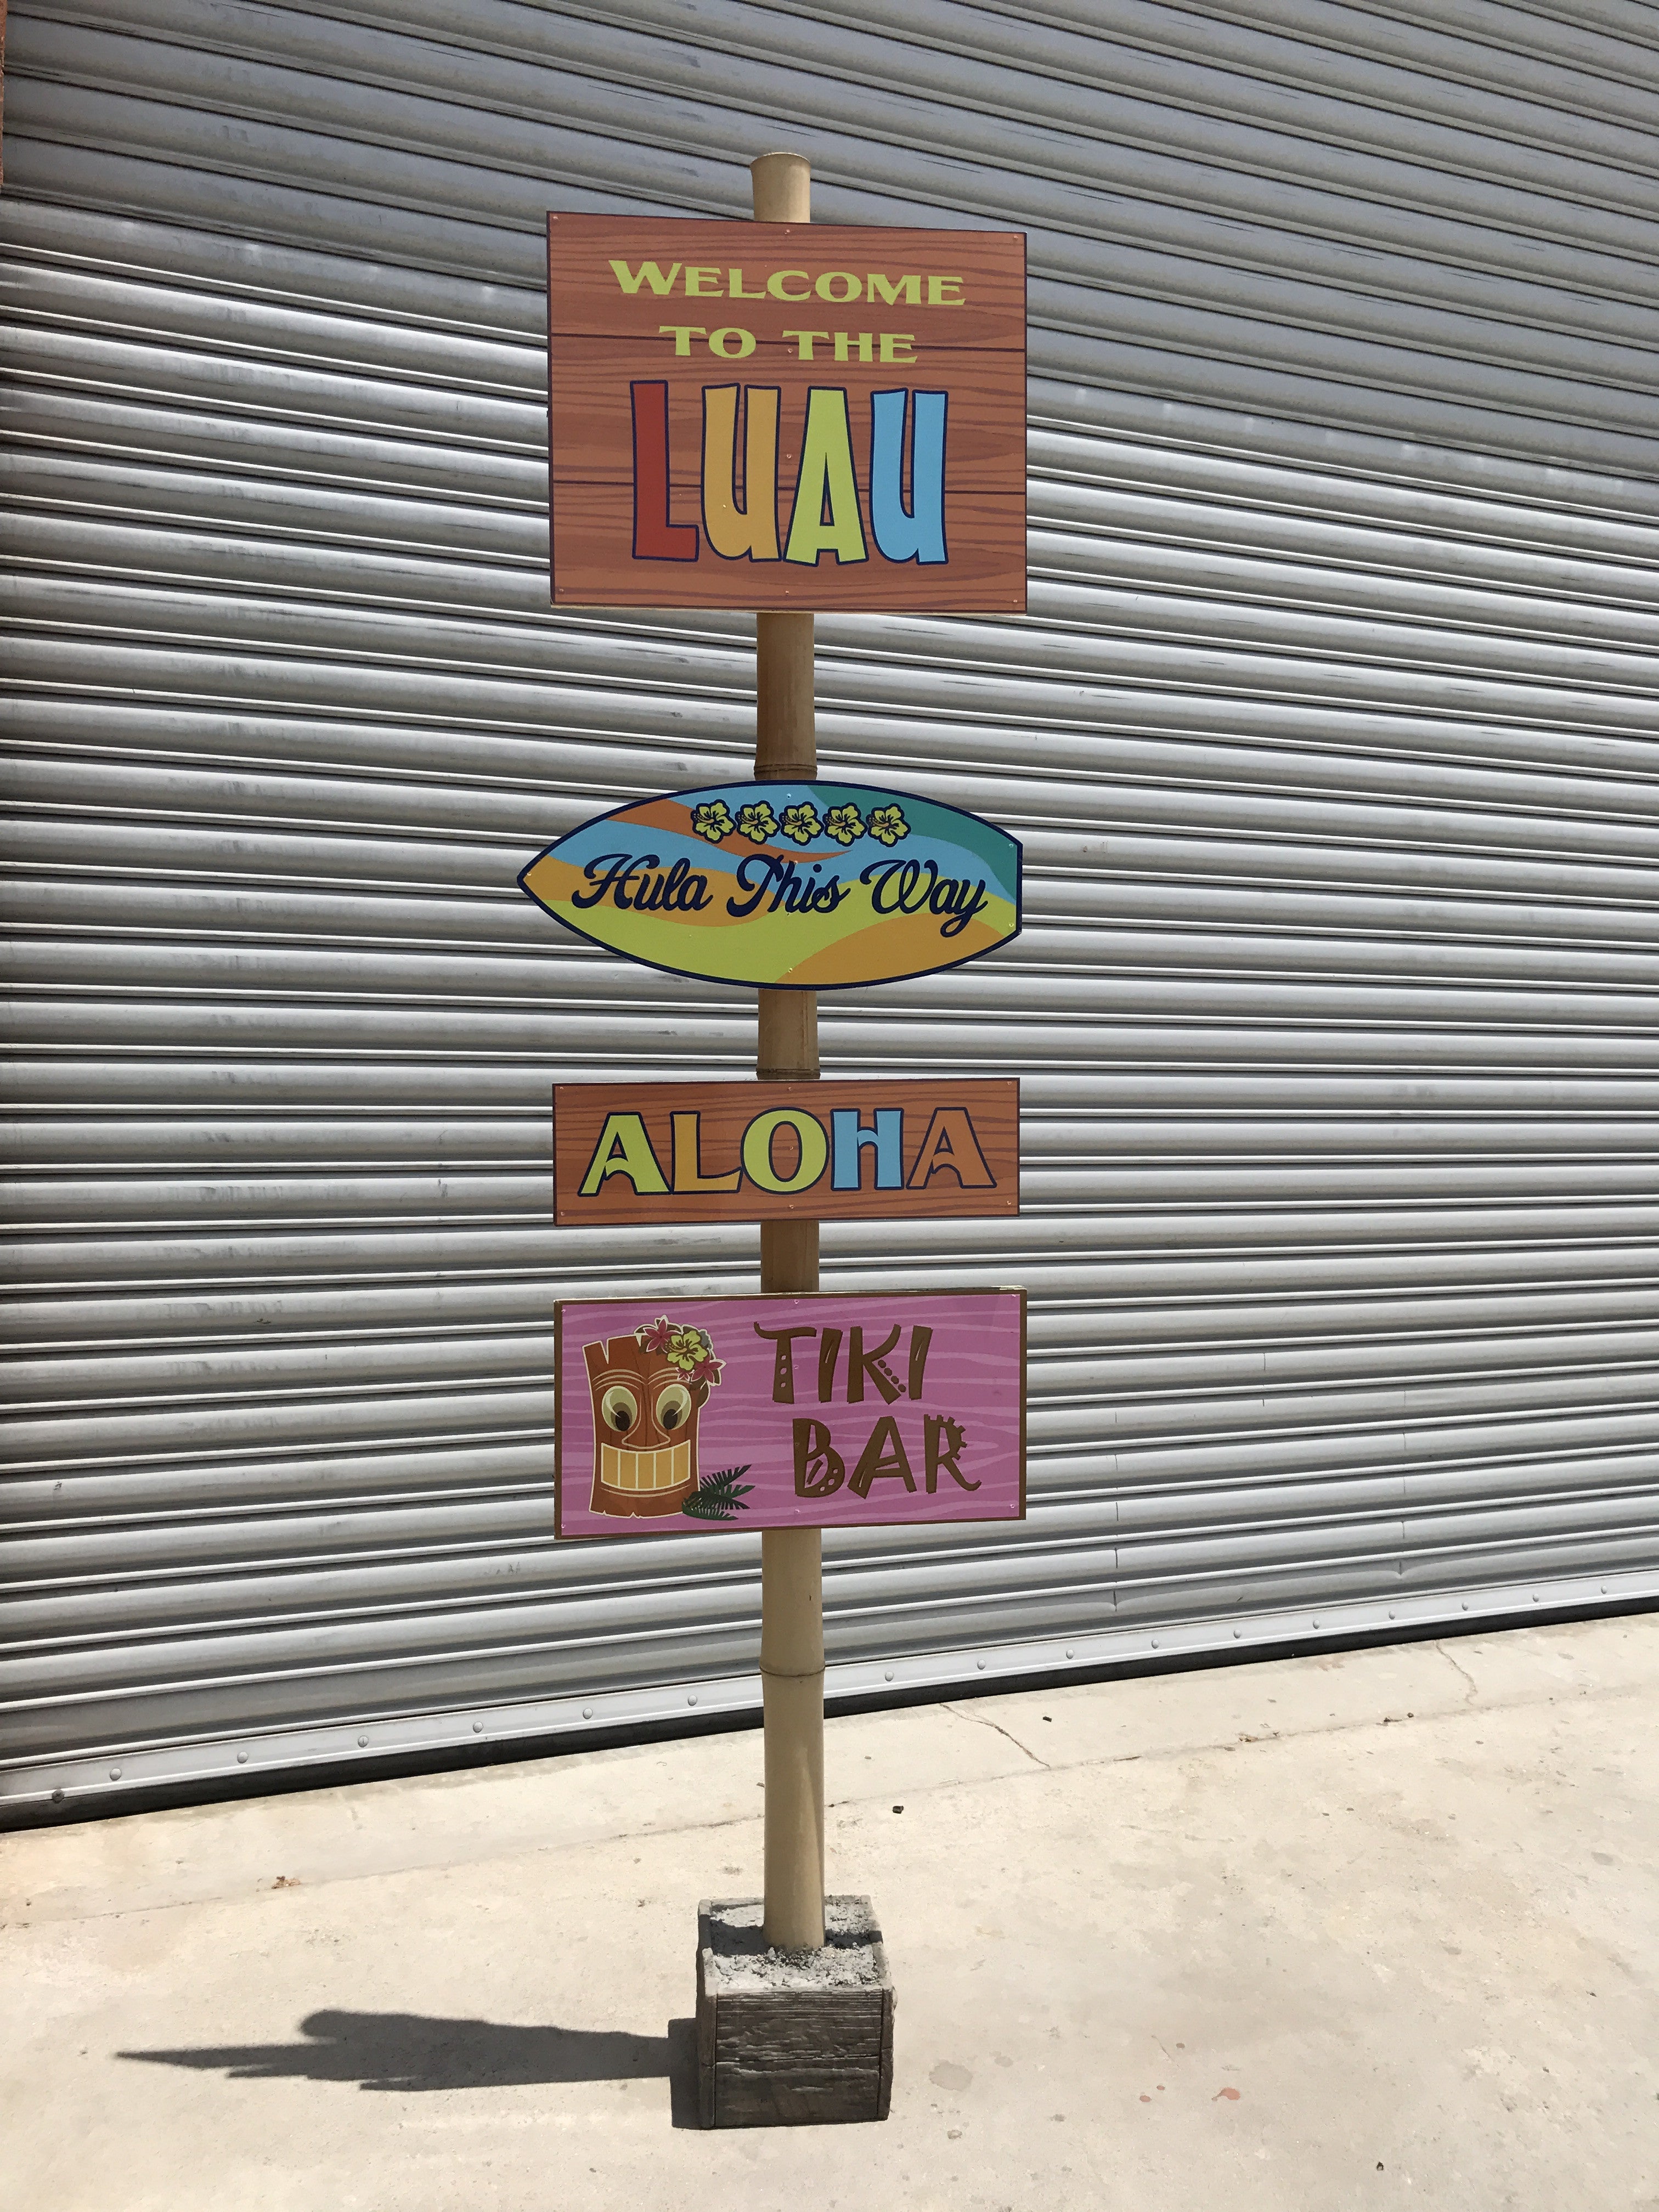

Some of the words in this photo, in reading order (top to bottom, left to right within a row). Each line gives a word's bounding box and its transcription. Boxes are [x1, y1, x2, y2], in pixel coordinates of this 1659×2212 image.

[608, 259, 966, 306] WELCOME
[659, 326, 757, 358] TO
[782, 330, 918, 363] THE
[630, 380, 949, 567] LUAU
[571, 854, 713, 911] Hula
[726, 854, 850, 917] This
[859, 859, 988, 938] Way
[577, 1106, 997, 1197] ALOHA
[754, 1322, 933, 1405] TIKI
[792, 1414, 982, 1499] BAR
